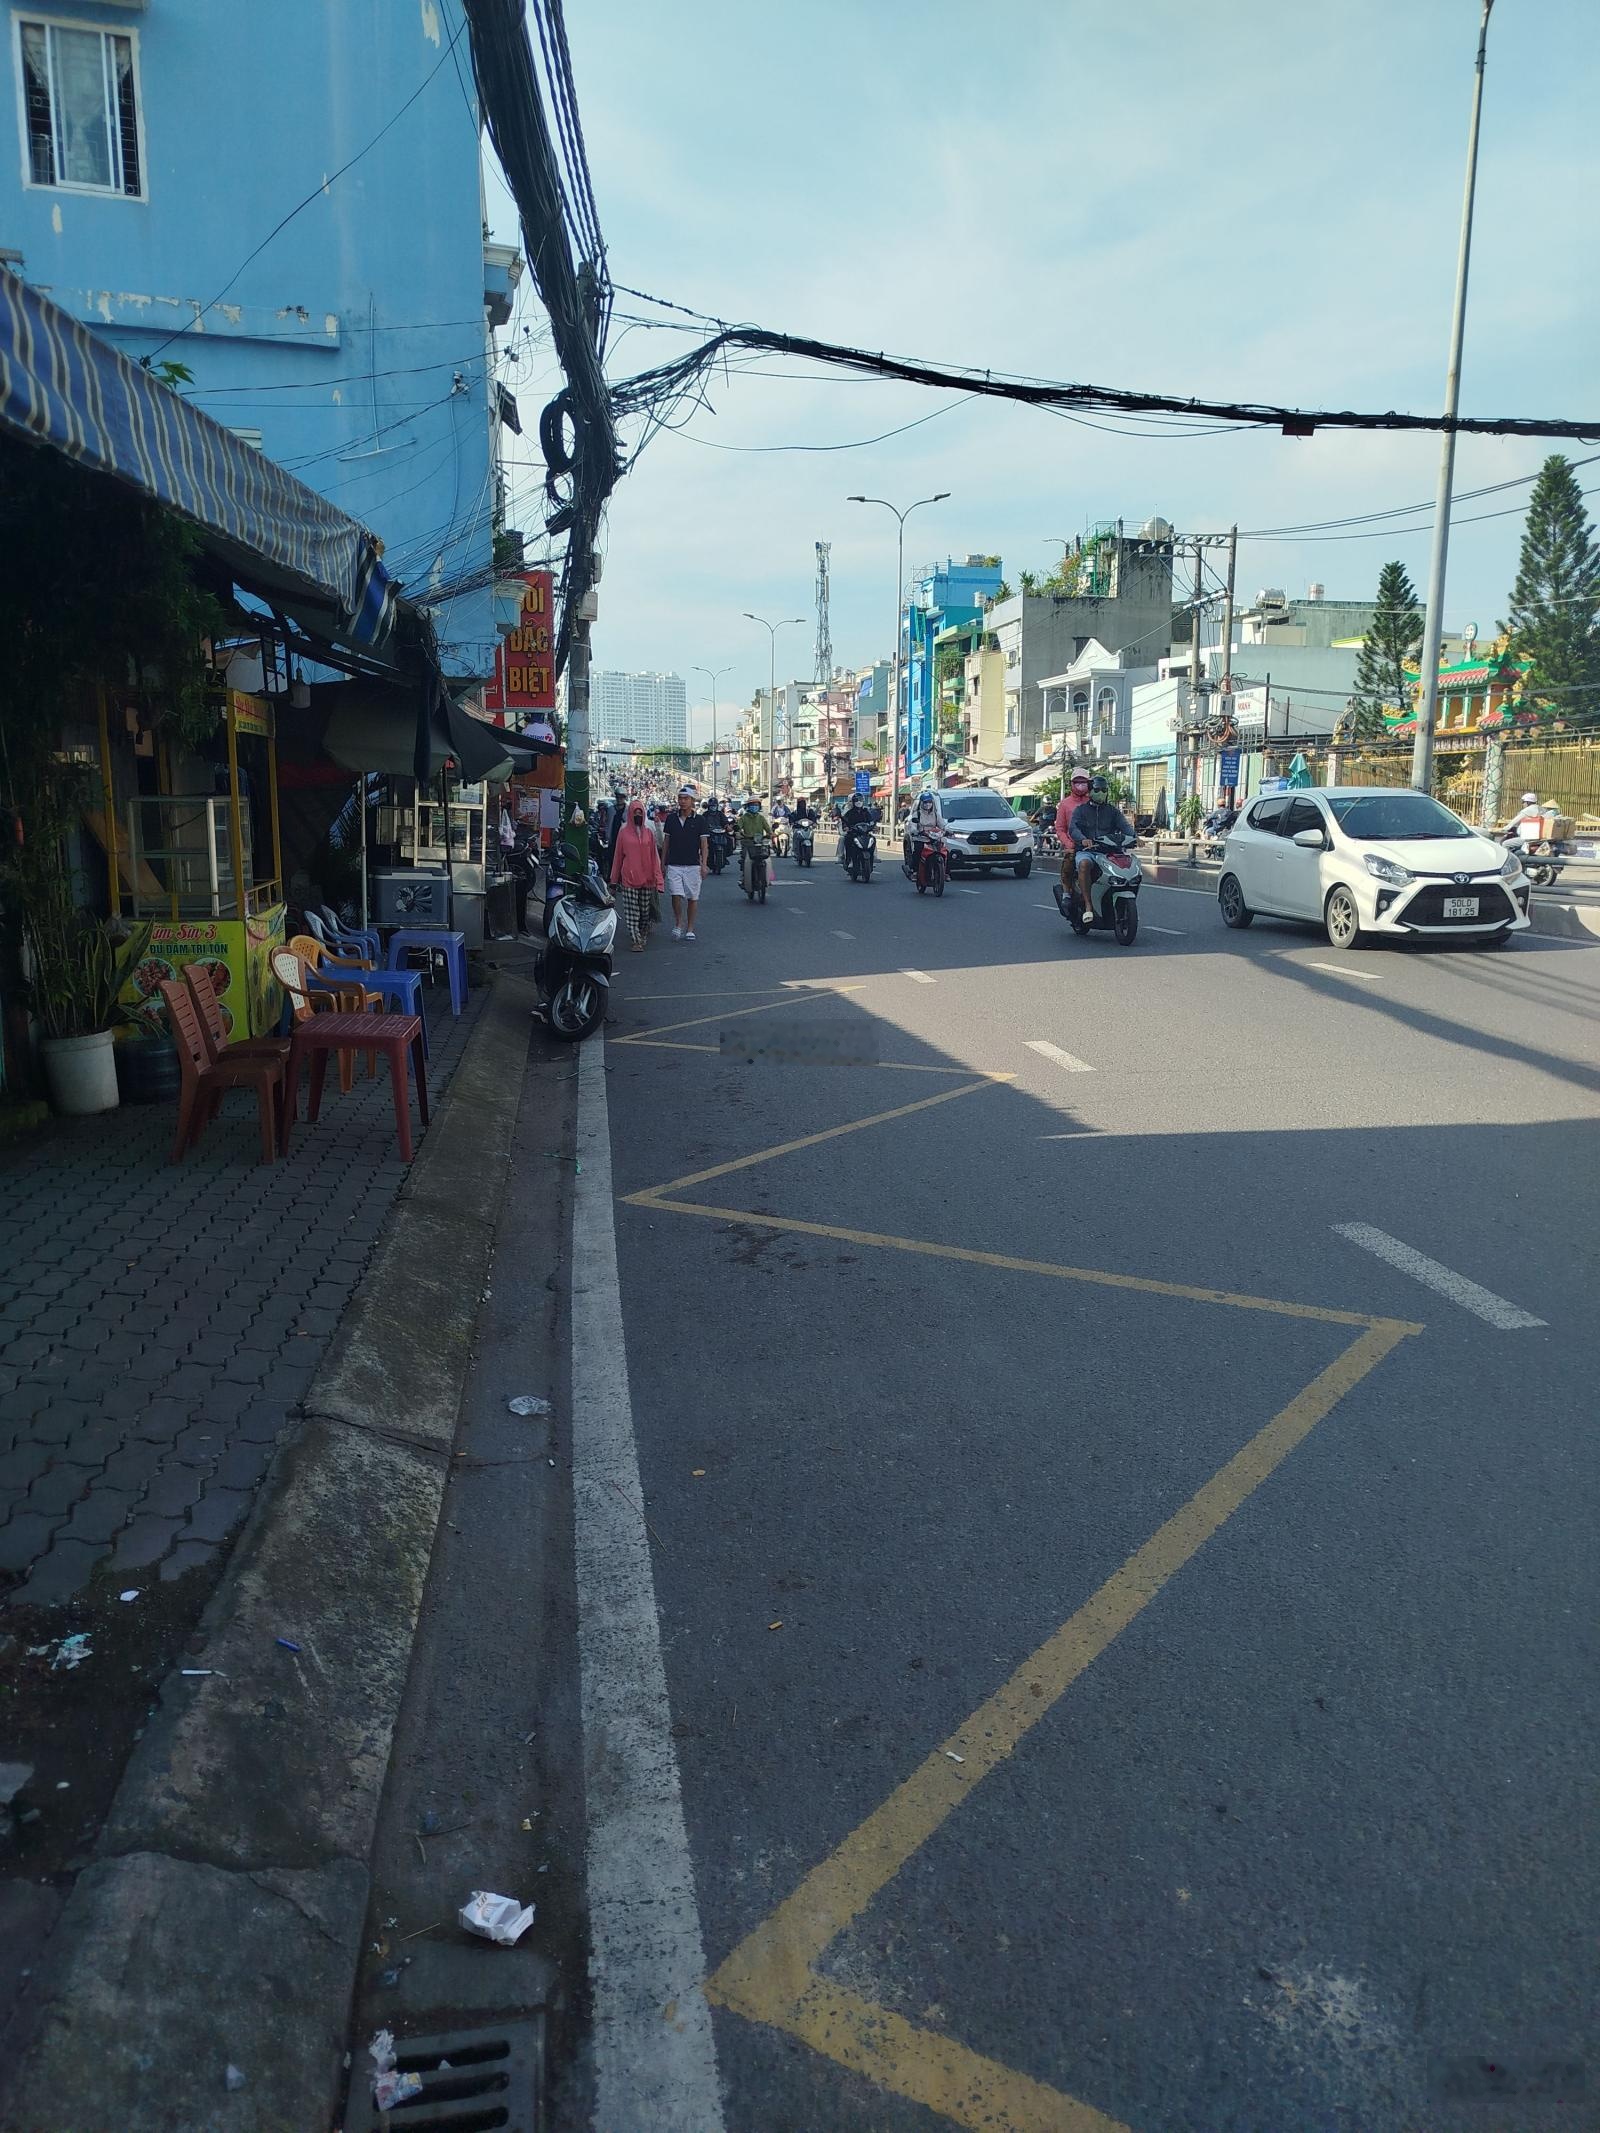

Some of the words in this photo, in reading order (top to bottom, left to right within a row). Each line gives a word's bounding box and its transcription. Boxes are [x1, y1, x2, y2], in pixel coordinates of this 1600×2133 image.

[510, 619, 549, 657] ĐẶC
[509, 661, 550, 697] BIỆT
[1448, 907, 1475, 916] 181.25
[204, 923, 217, 940] 3
